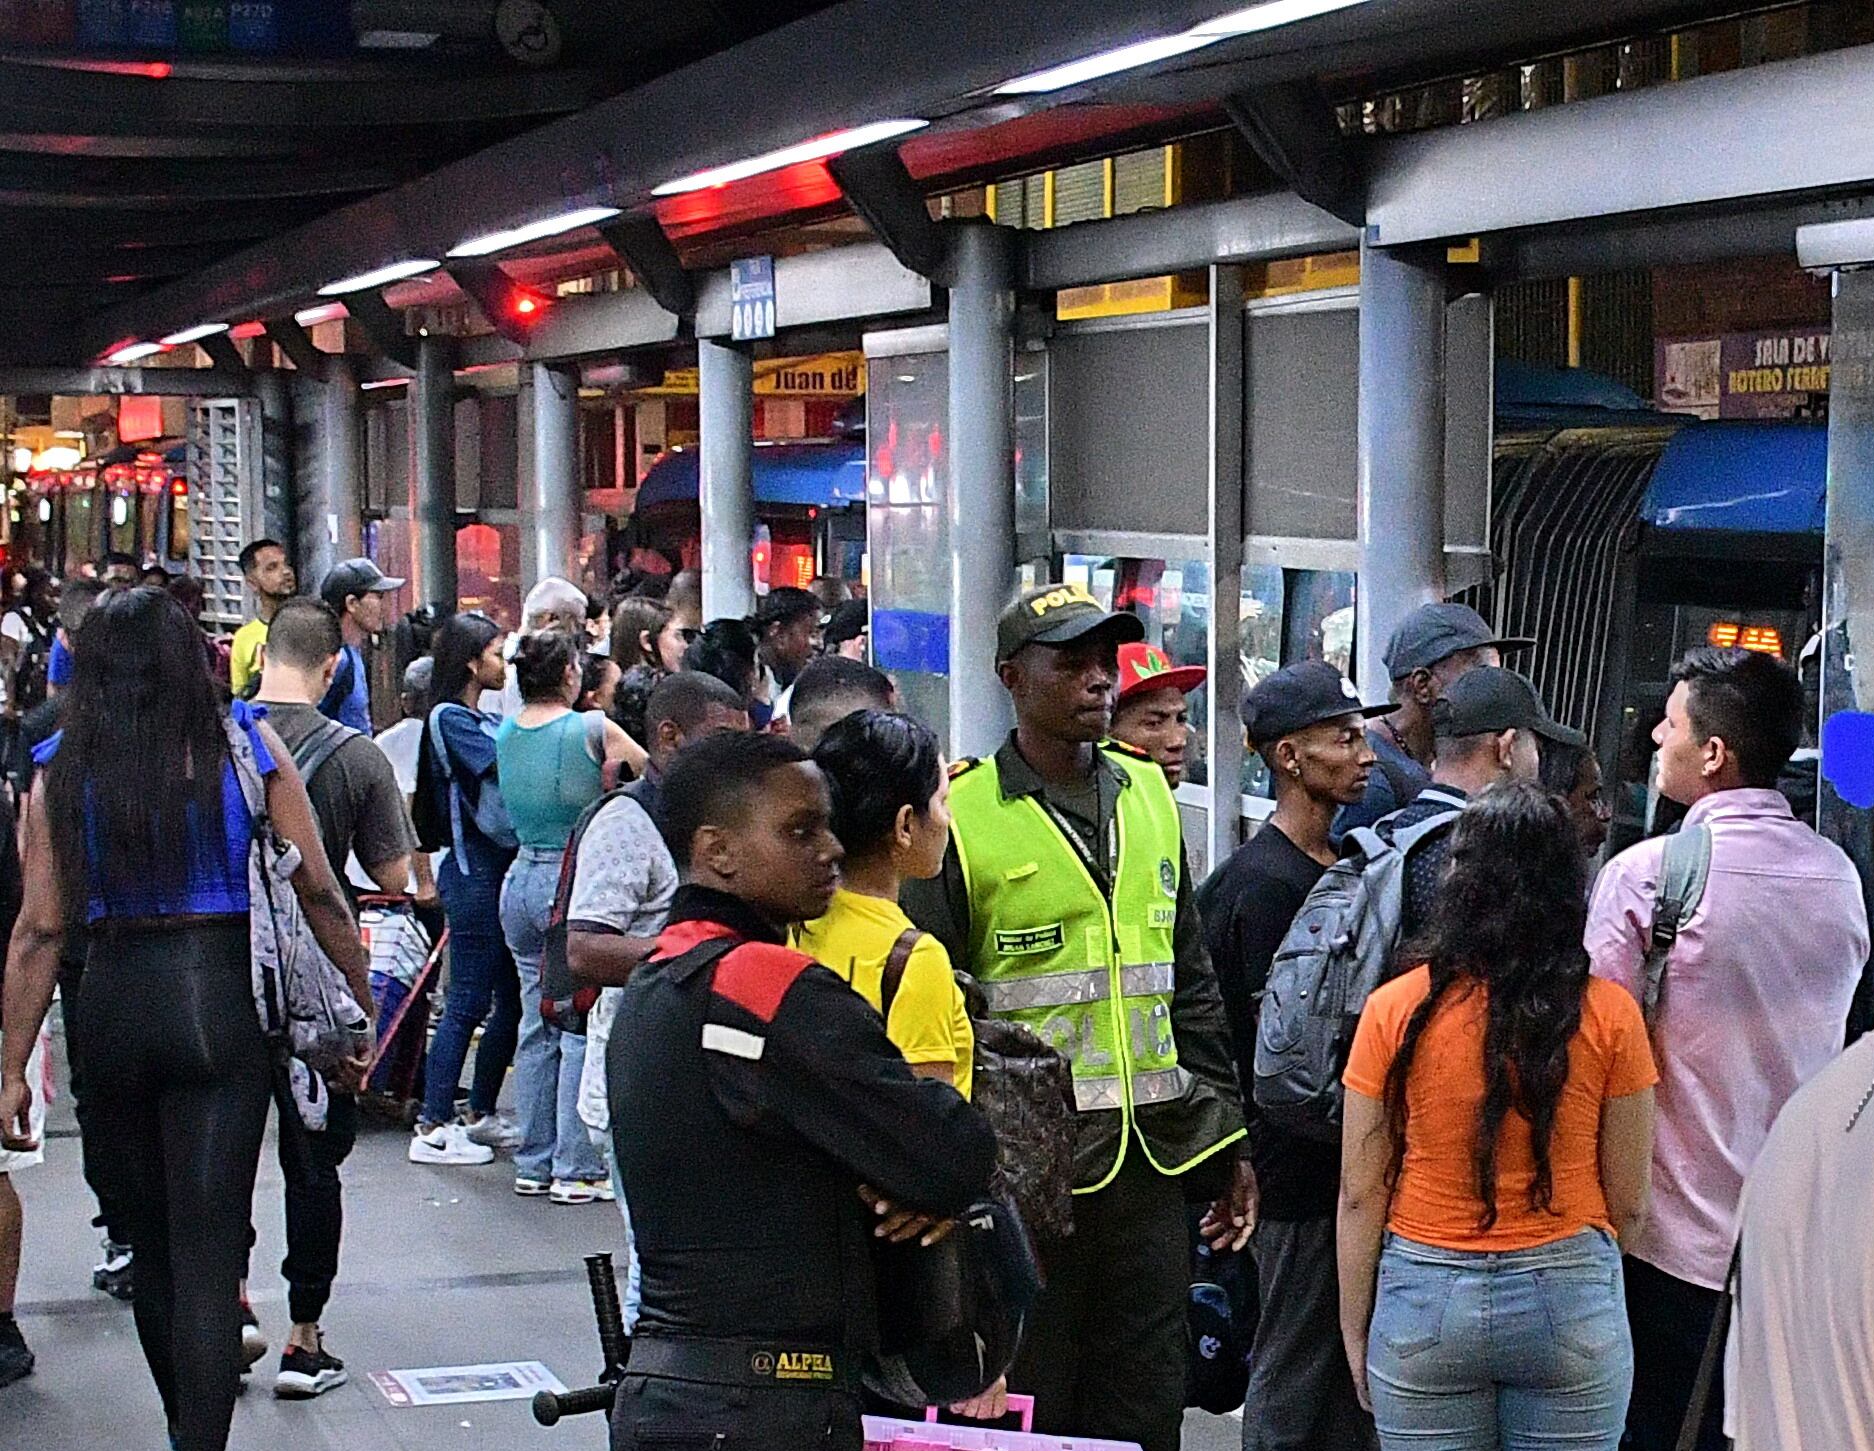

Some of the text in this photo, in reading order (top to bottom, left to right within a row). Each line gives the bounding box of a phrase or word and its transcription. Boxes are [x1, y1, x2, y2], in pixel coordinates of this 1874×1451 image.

[1755, 337, 1790, 367] SALA
[1793, 335, 1816, 364] DE
[774, 368, 825, 390] Juan
